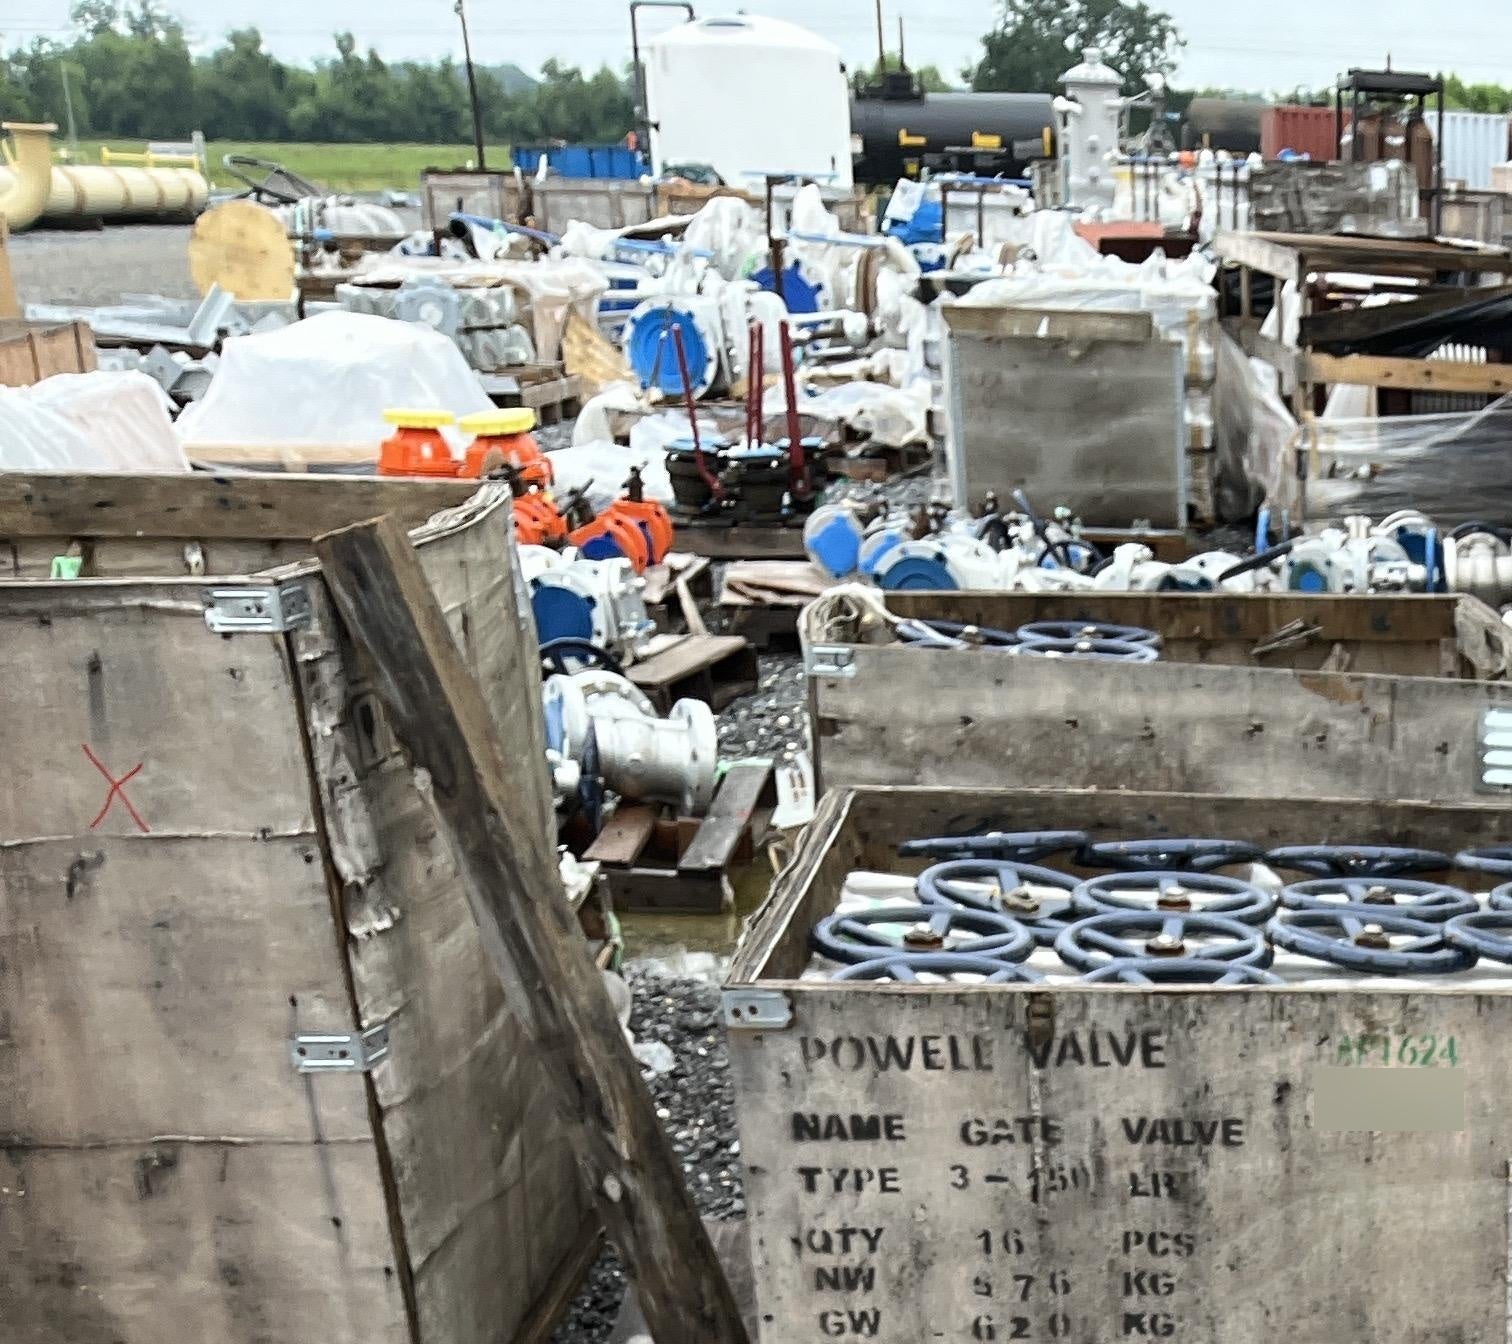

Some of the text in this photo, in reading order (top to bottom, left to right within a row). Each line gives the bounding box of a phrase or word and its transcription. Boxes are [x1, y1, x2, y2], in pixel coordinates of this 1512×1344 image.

[800, 1030, 1167, 1072] POWELL VALVE
[792, 1112, 1245, 1147] NAME GATE VALVE
[799, 1166, 901, 1194] TYPE
[806, 1226, 1197, 1257] QTY 16 PCS
[815, 1266, 875, 1292] NW
[1123, 1270, 1176, 1297] KG
[819, 1309, 882, 1336] GW
[1123, 1312, 1176, 1338] KG
